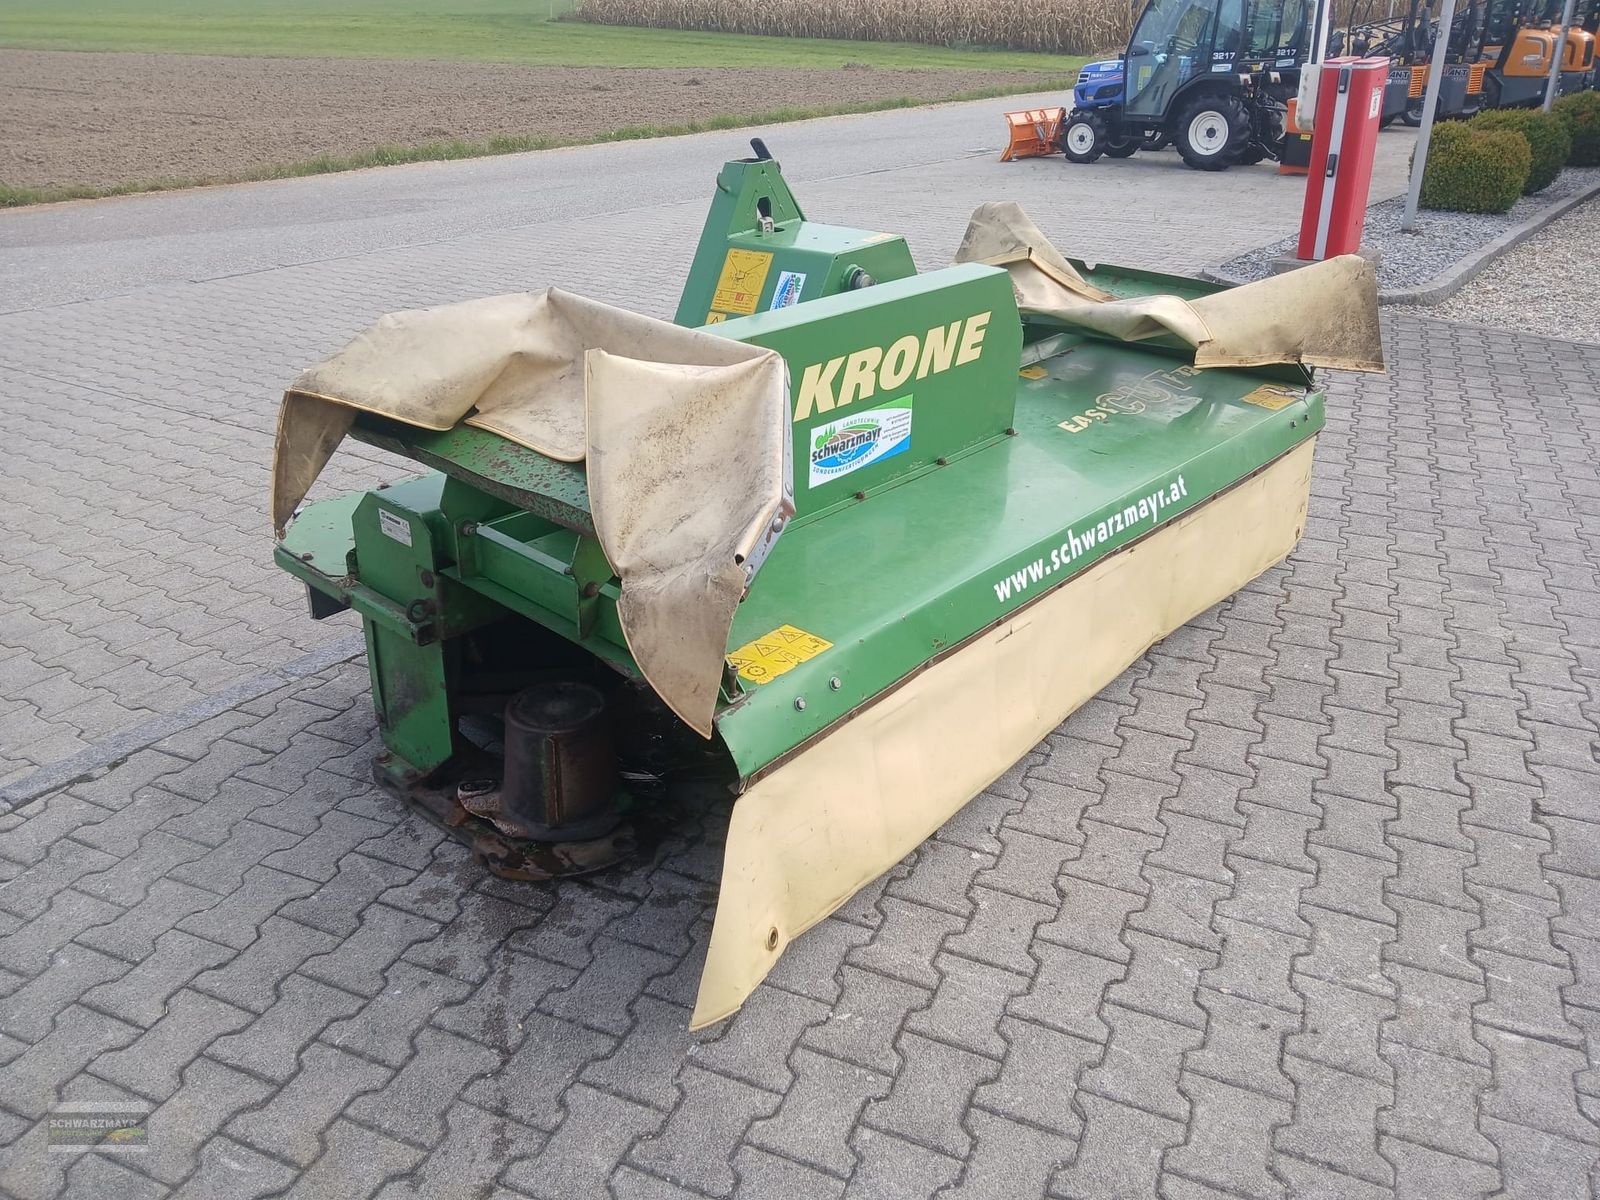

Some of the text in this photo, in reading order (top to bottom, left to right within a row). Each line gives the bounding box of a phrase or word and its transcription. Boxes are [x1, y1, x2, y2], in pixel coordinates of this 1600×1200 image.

[1212, 52, 1236, 60] 3217
[1388, 69, 1411, 80] ANT
[793, 311, 992, 423] KRONE
[811, 426, 882, 463] schwarzmayr
[993, 473, 1188, 603] www.schwarzmayr.at
